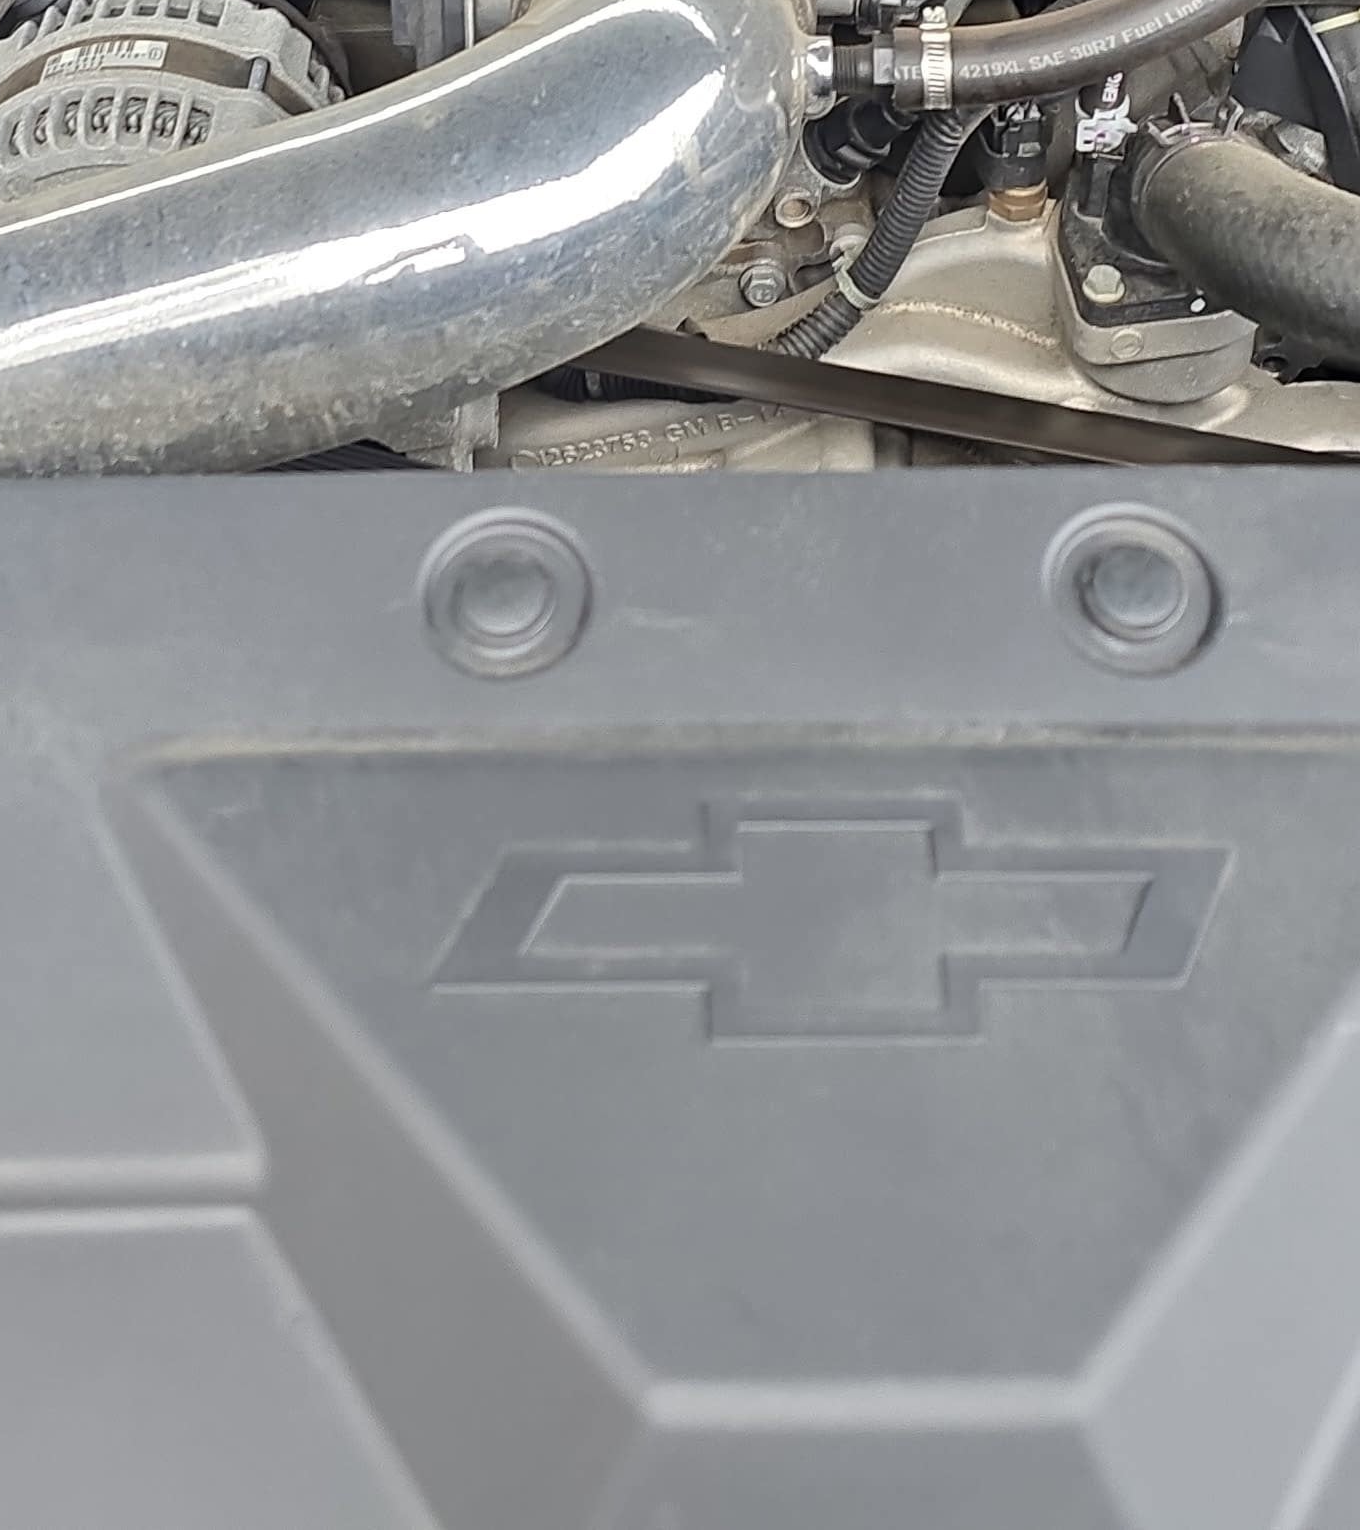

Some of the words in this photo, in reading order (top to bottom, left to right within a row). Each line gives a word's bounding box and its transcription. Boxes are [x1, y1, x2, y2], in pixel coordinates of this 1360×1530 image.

[959, 58, 1024, 80] 4219XL
[1028, 50, 1067, 72] SAE
[1069, 34, 1118, 63] 30R7
[1121, 19, 1163, 45] Fuel
[1101, 71, 1125, 104] ENG
